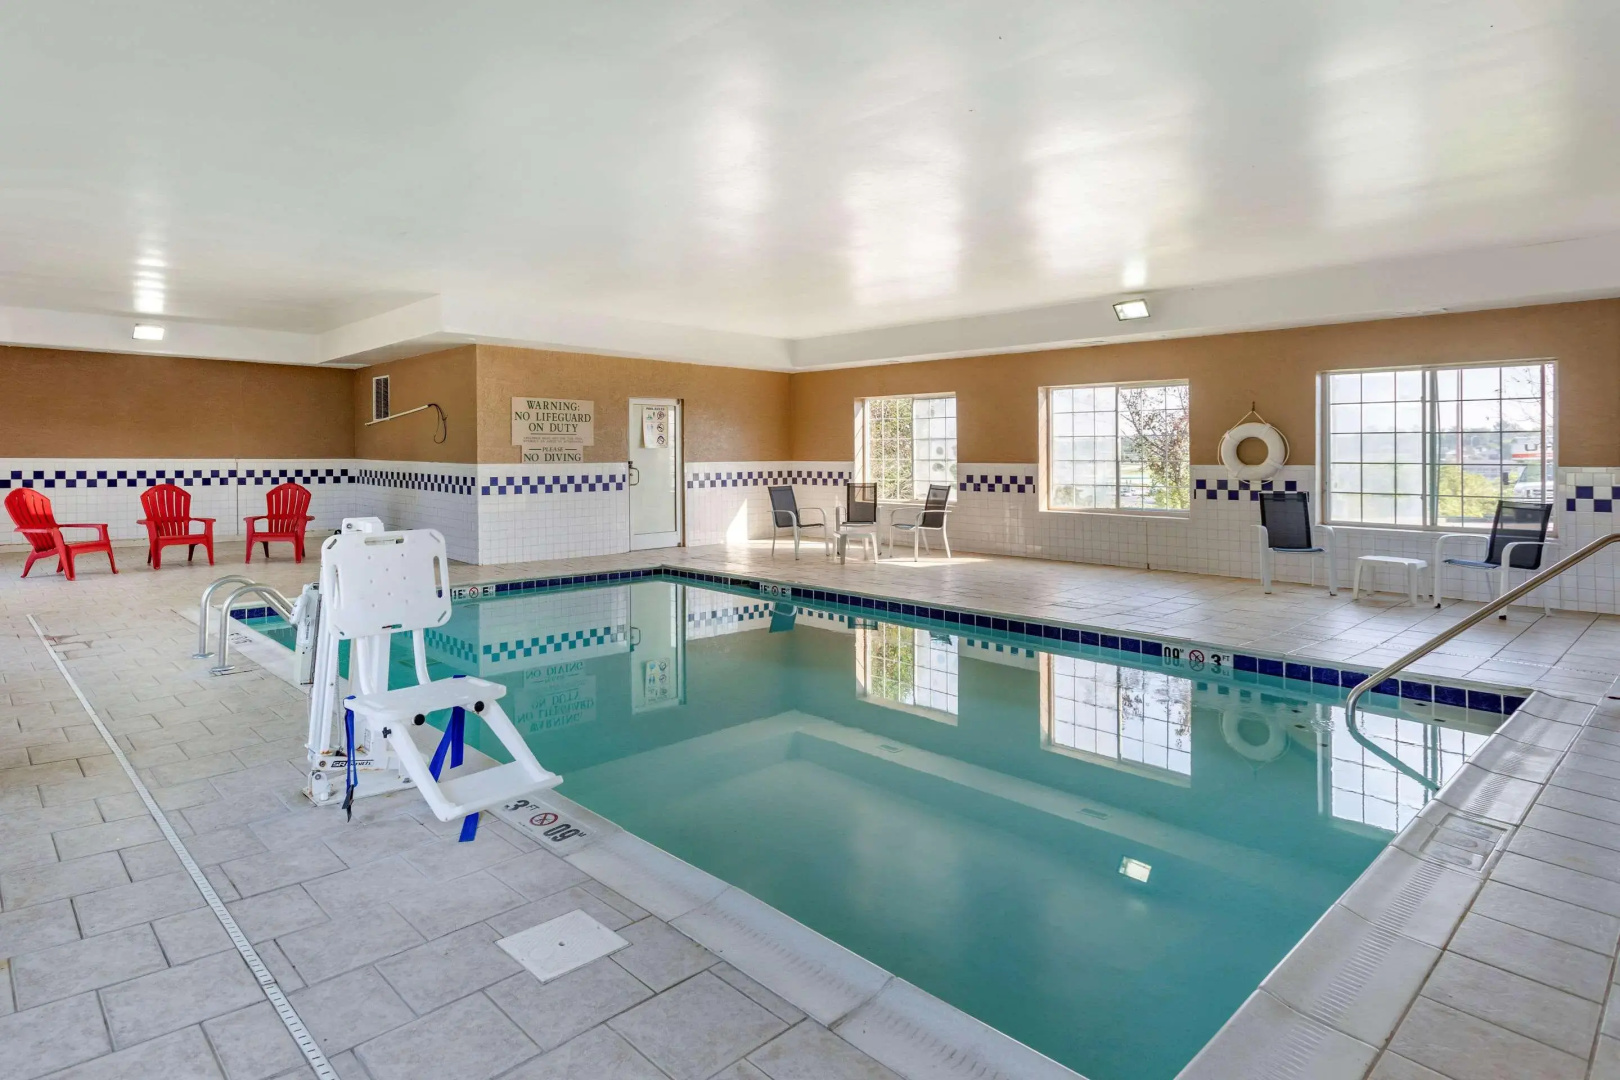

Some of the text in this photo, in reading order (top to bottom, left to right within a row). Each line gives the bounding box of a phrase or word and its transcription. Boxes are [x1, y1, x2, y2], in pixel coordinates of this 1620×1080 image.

[526, 400, 580, 411] WARNING:
[514, 411, 592, 423] NO LIFEGUARD
[528, 422, 578, 433] ON DUTY
[523, 453, 582, 462] NO DIVING
